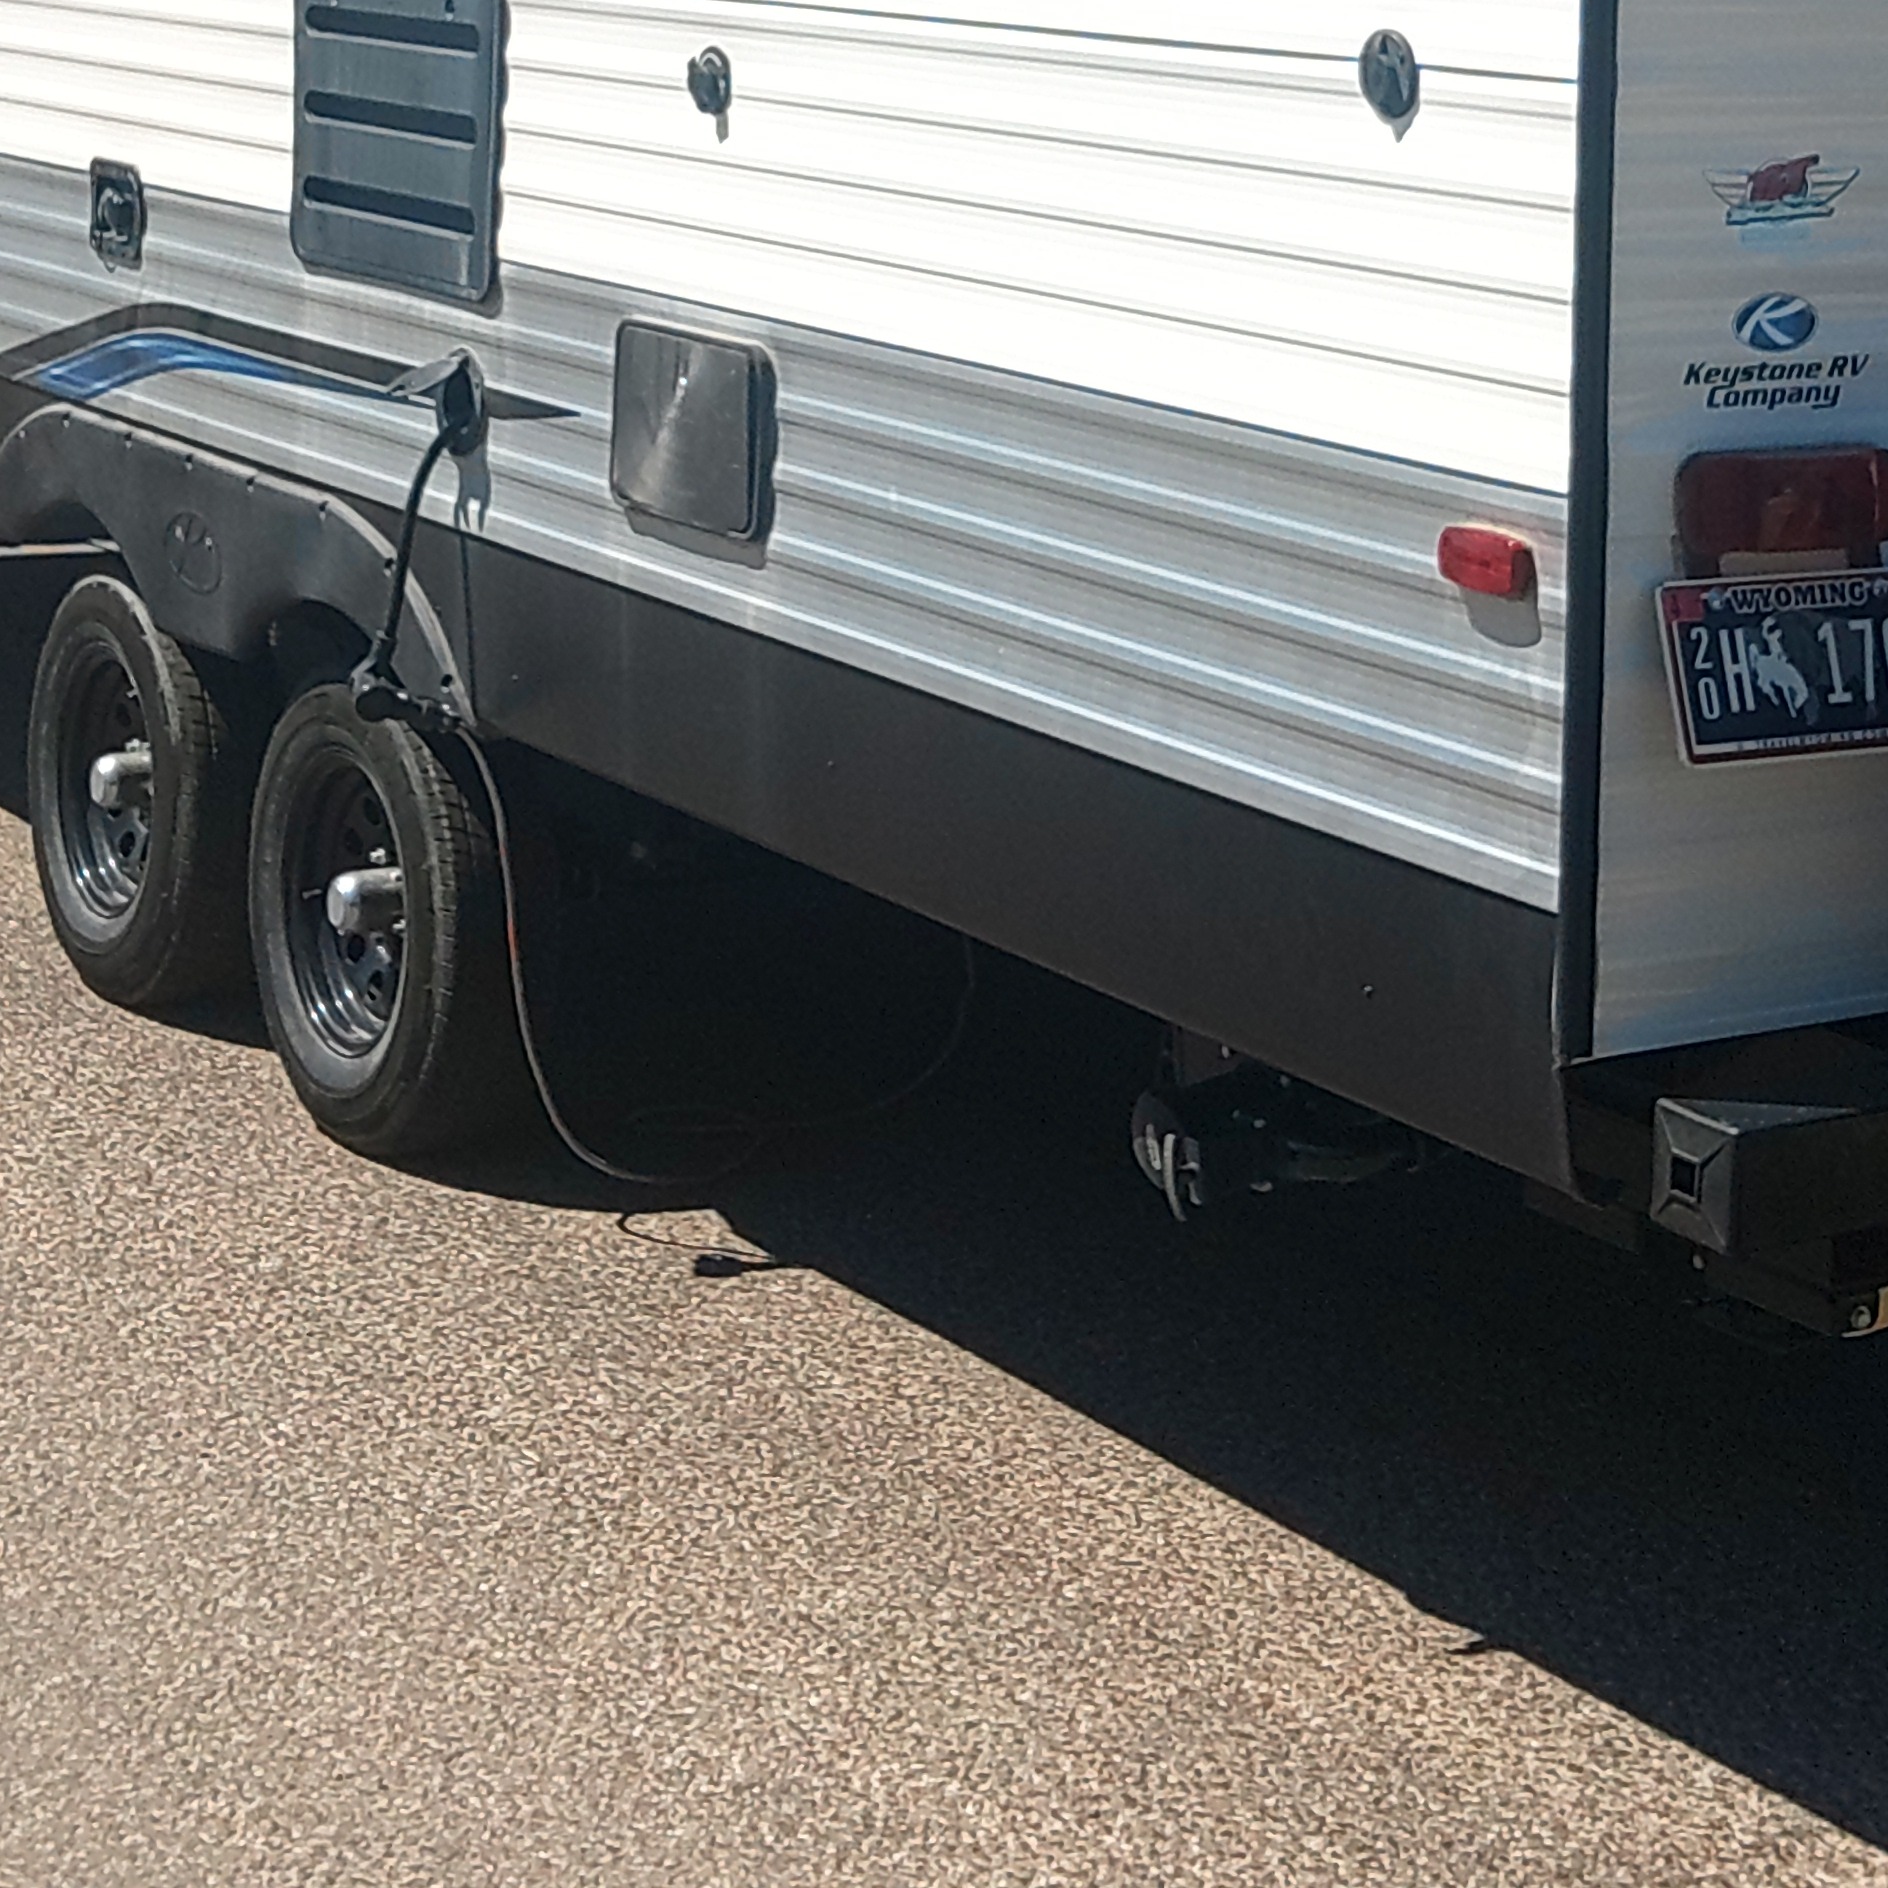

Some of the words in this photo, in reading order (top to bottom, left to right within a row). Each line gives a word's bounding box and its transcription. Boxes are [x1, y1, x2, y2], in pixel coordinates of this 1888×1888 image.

[1684, 361, 1823, 388] Keystone
[1827, 354, 1870, 378] RV
[1706, 384, 1841, 410] Company
[1729, 580, 1869, 612] WYOMING
